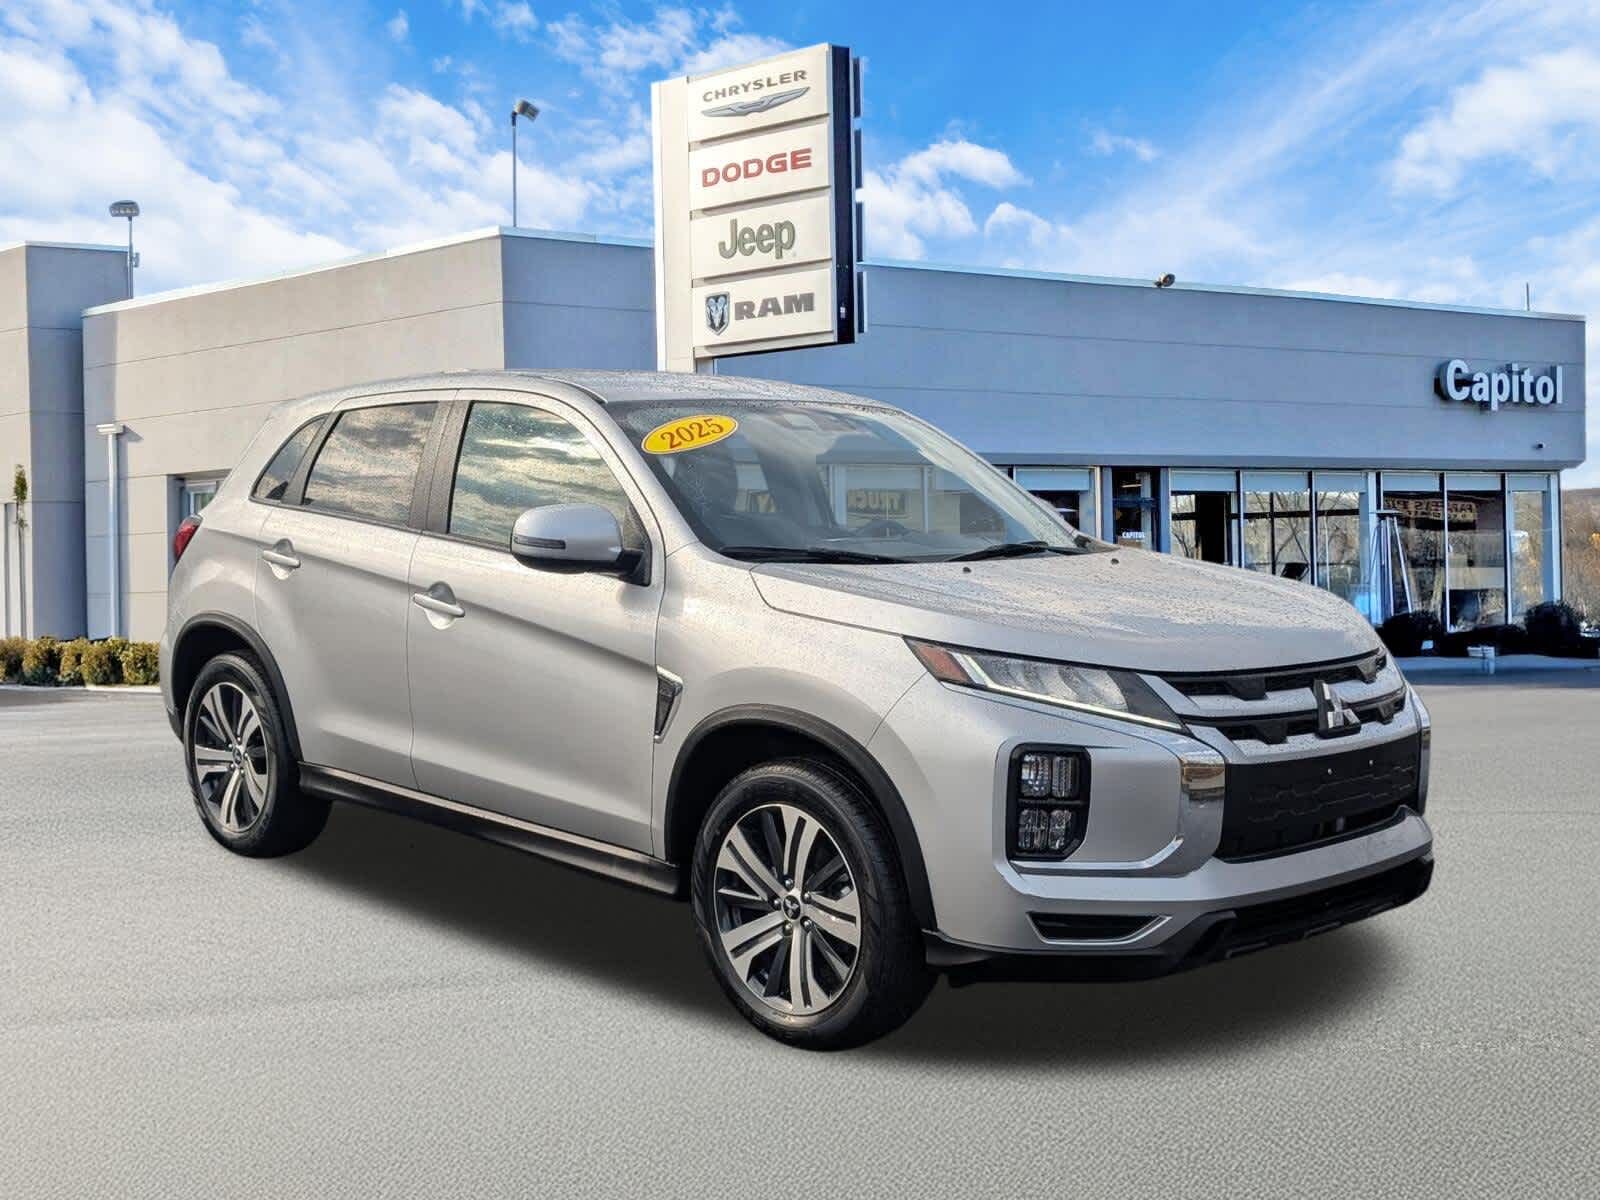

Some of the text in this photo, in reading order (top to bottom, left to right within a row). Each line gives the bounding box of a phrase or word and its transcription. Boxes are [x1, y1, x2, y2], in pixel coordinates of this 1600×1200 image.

[703, 69, 807, 103] CHRYSLER
[702, 148, 812, 188] DODGE
[719, 219, 795, 260] Jeep
[734, 292, 815, 321] RAM
[1445, 359, 1563, 411] Capitol
[660, 418, 724, 449] 2025
